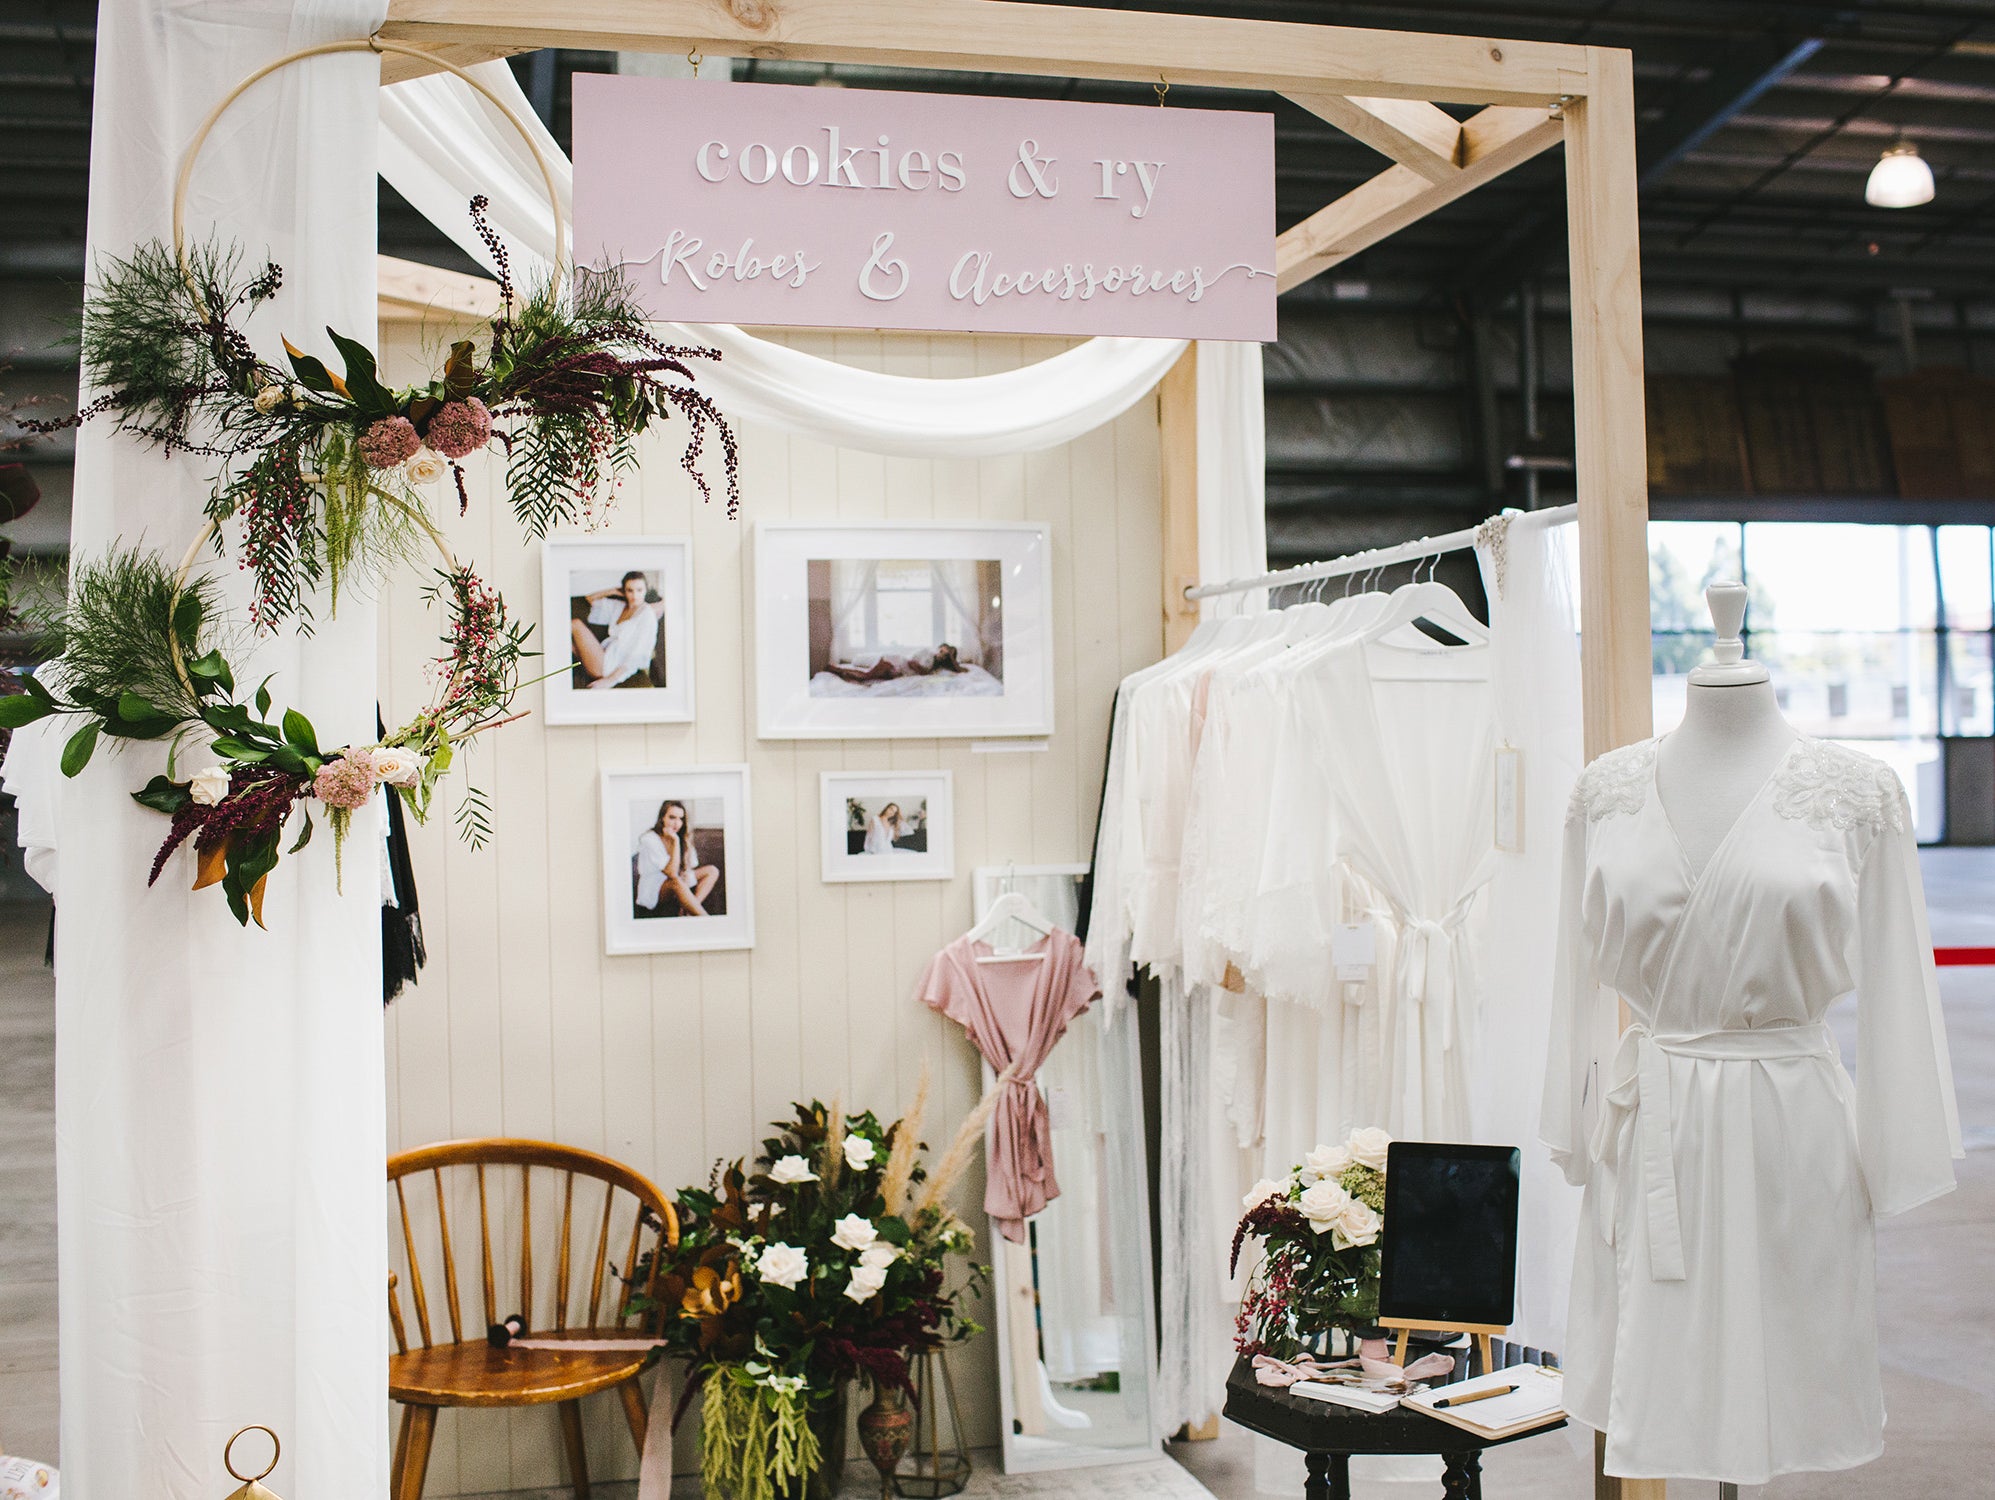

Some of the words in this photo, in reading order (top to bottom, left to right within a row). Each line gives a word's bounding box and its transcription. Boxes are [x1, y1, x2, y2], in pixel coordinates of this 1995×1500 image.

[696, 126, 967, 192] cookies
[1005, 139, 1058, 199] &
[1094, 156, 1167, 218] ry
[657, 229, 821, 292] Robes
[858, 231, 911, 302] &
[948, 250, 1212, 306] Accessories
